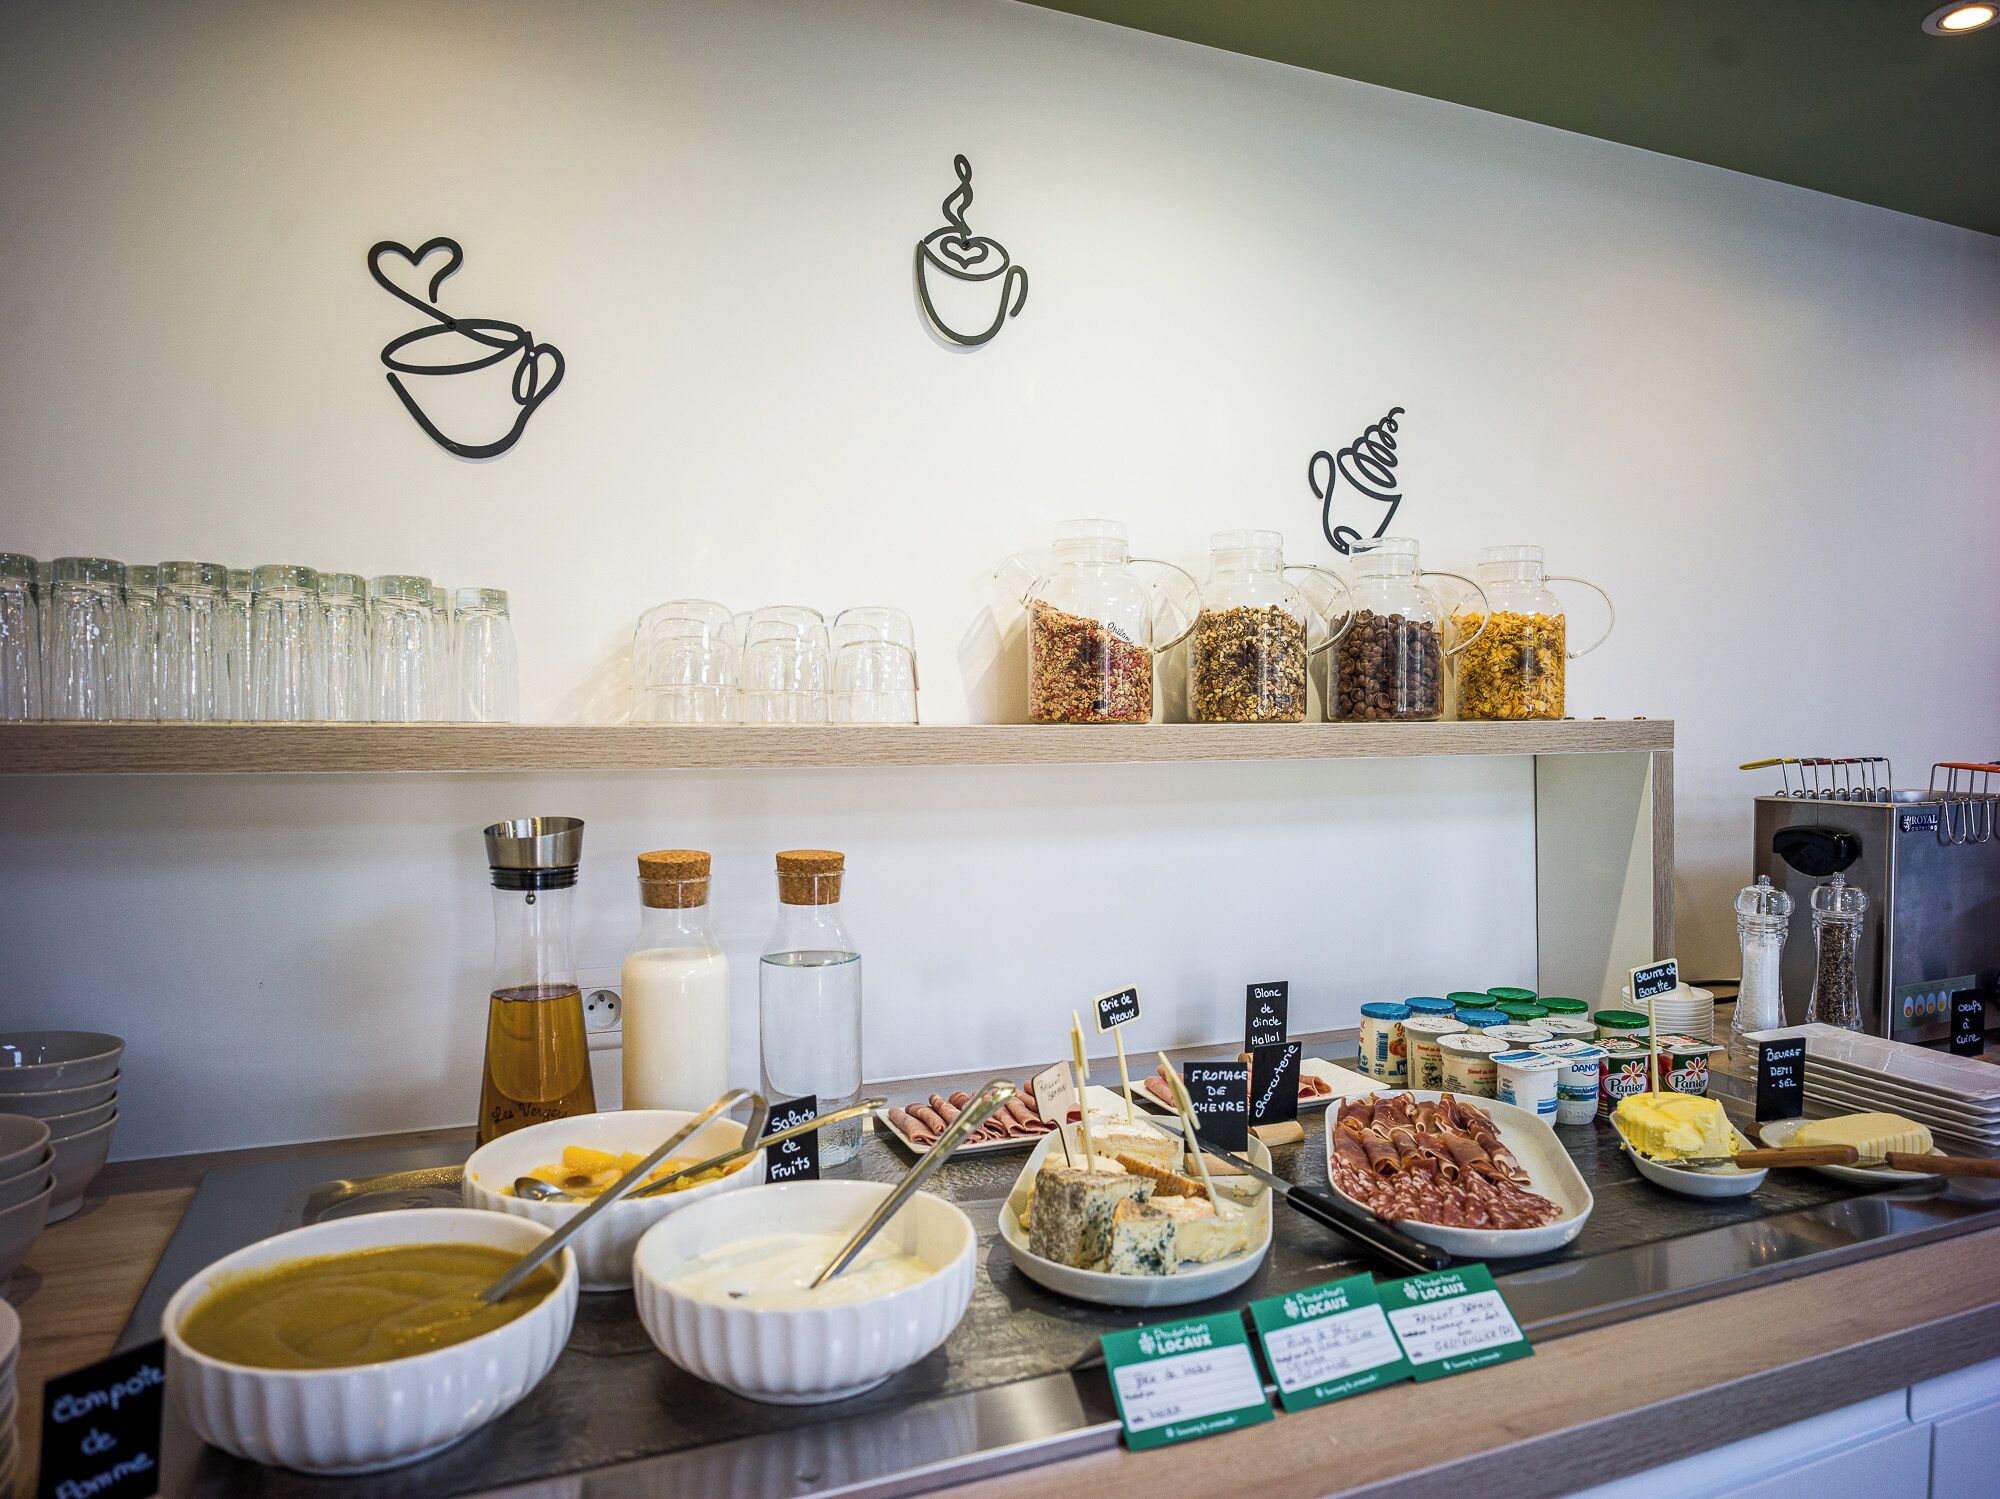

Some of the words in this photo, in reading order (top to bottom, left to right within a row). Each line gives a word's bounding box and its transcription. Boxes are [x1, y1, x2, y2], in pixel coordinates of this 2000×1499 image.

[1911, 815, 1938, 825] ROYAL
[1635, 968, 1665, 983] Beurre
[1254, 987, 1282, 999] Blanc
[1100, 998, 1120, 1013] Brie
[1120, 993, 1133, 1006] de
[1260, 1003, 1274, 1014] de
[1109, 1008, 1135, 1026] Meaux
[1252, 1015, 1282, 1028] dinde
[1962, 1017, 1970, 1030] à
[1956, 1034, 1981, 1044] cuire
[1191, 1069, 1249, 1083] FROMAGE
[1770, 1065, 1793, 1077] DEMI
[1608, 1078, 1644, 1093] Panier
[1672, 1074, 1707, 1088] Panier
[1778, 1078, 1797, 1089] SEL
[1206, 1085, 1227, 1096] DE
[1191, 1098, 1245, 1114] CHÈVRE
[771, 1108, 815, 1132] Salade
[781, 1138, 800, 1154] de
[770, 1156, 811, 1180] Fruits
[1420, 1281, 1467, 1300] LOCAUX
[1301, 1296, 1350, 1318] LOCAUX
[1156, 1333, 1213, 1355] LOCAUX
[51, 1364, 166, 1424] Compote
[80, 1426, 118, 1456] de
